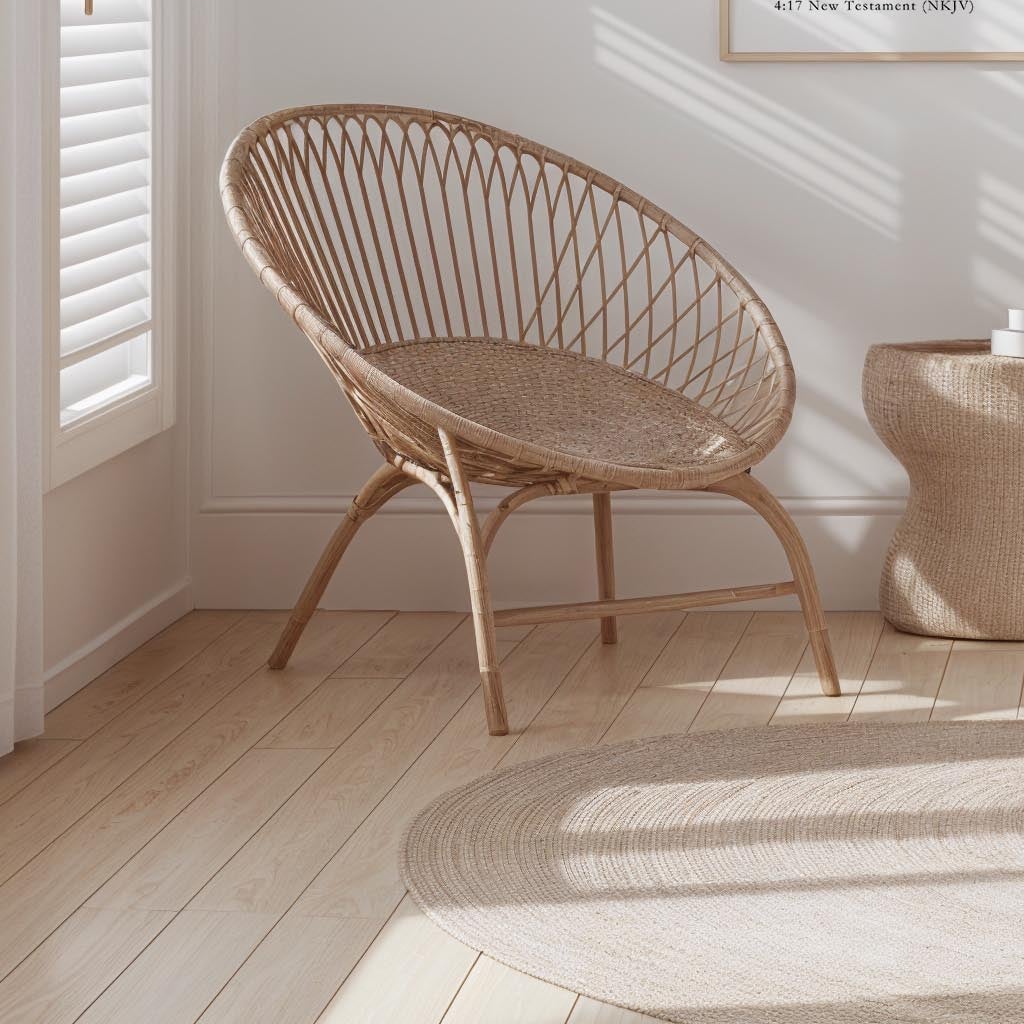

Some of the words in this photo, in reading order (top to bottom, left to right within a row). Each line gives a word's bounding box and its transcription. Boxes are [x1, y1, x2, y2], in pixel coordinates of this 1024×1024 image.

[774, 0, 803, 11] 4:17
[808, 0, 840, 12] New
[844, 0, 917, 12] Testament
[921, 0, 975, 15] (NKJV)
